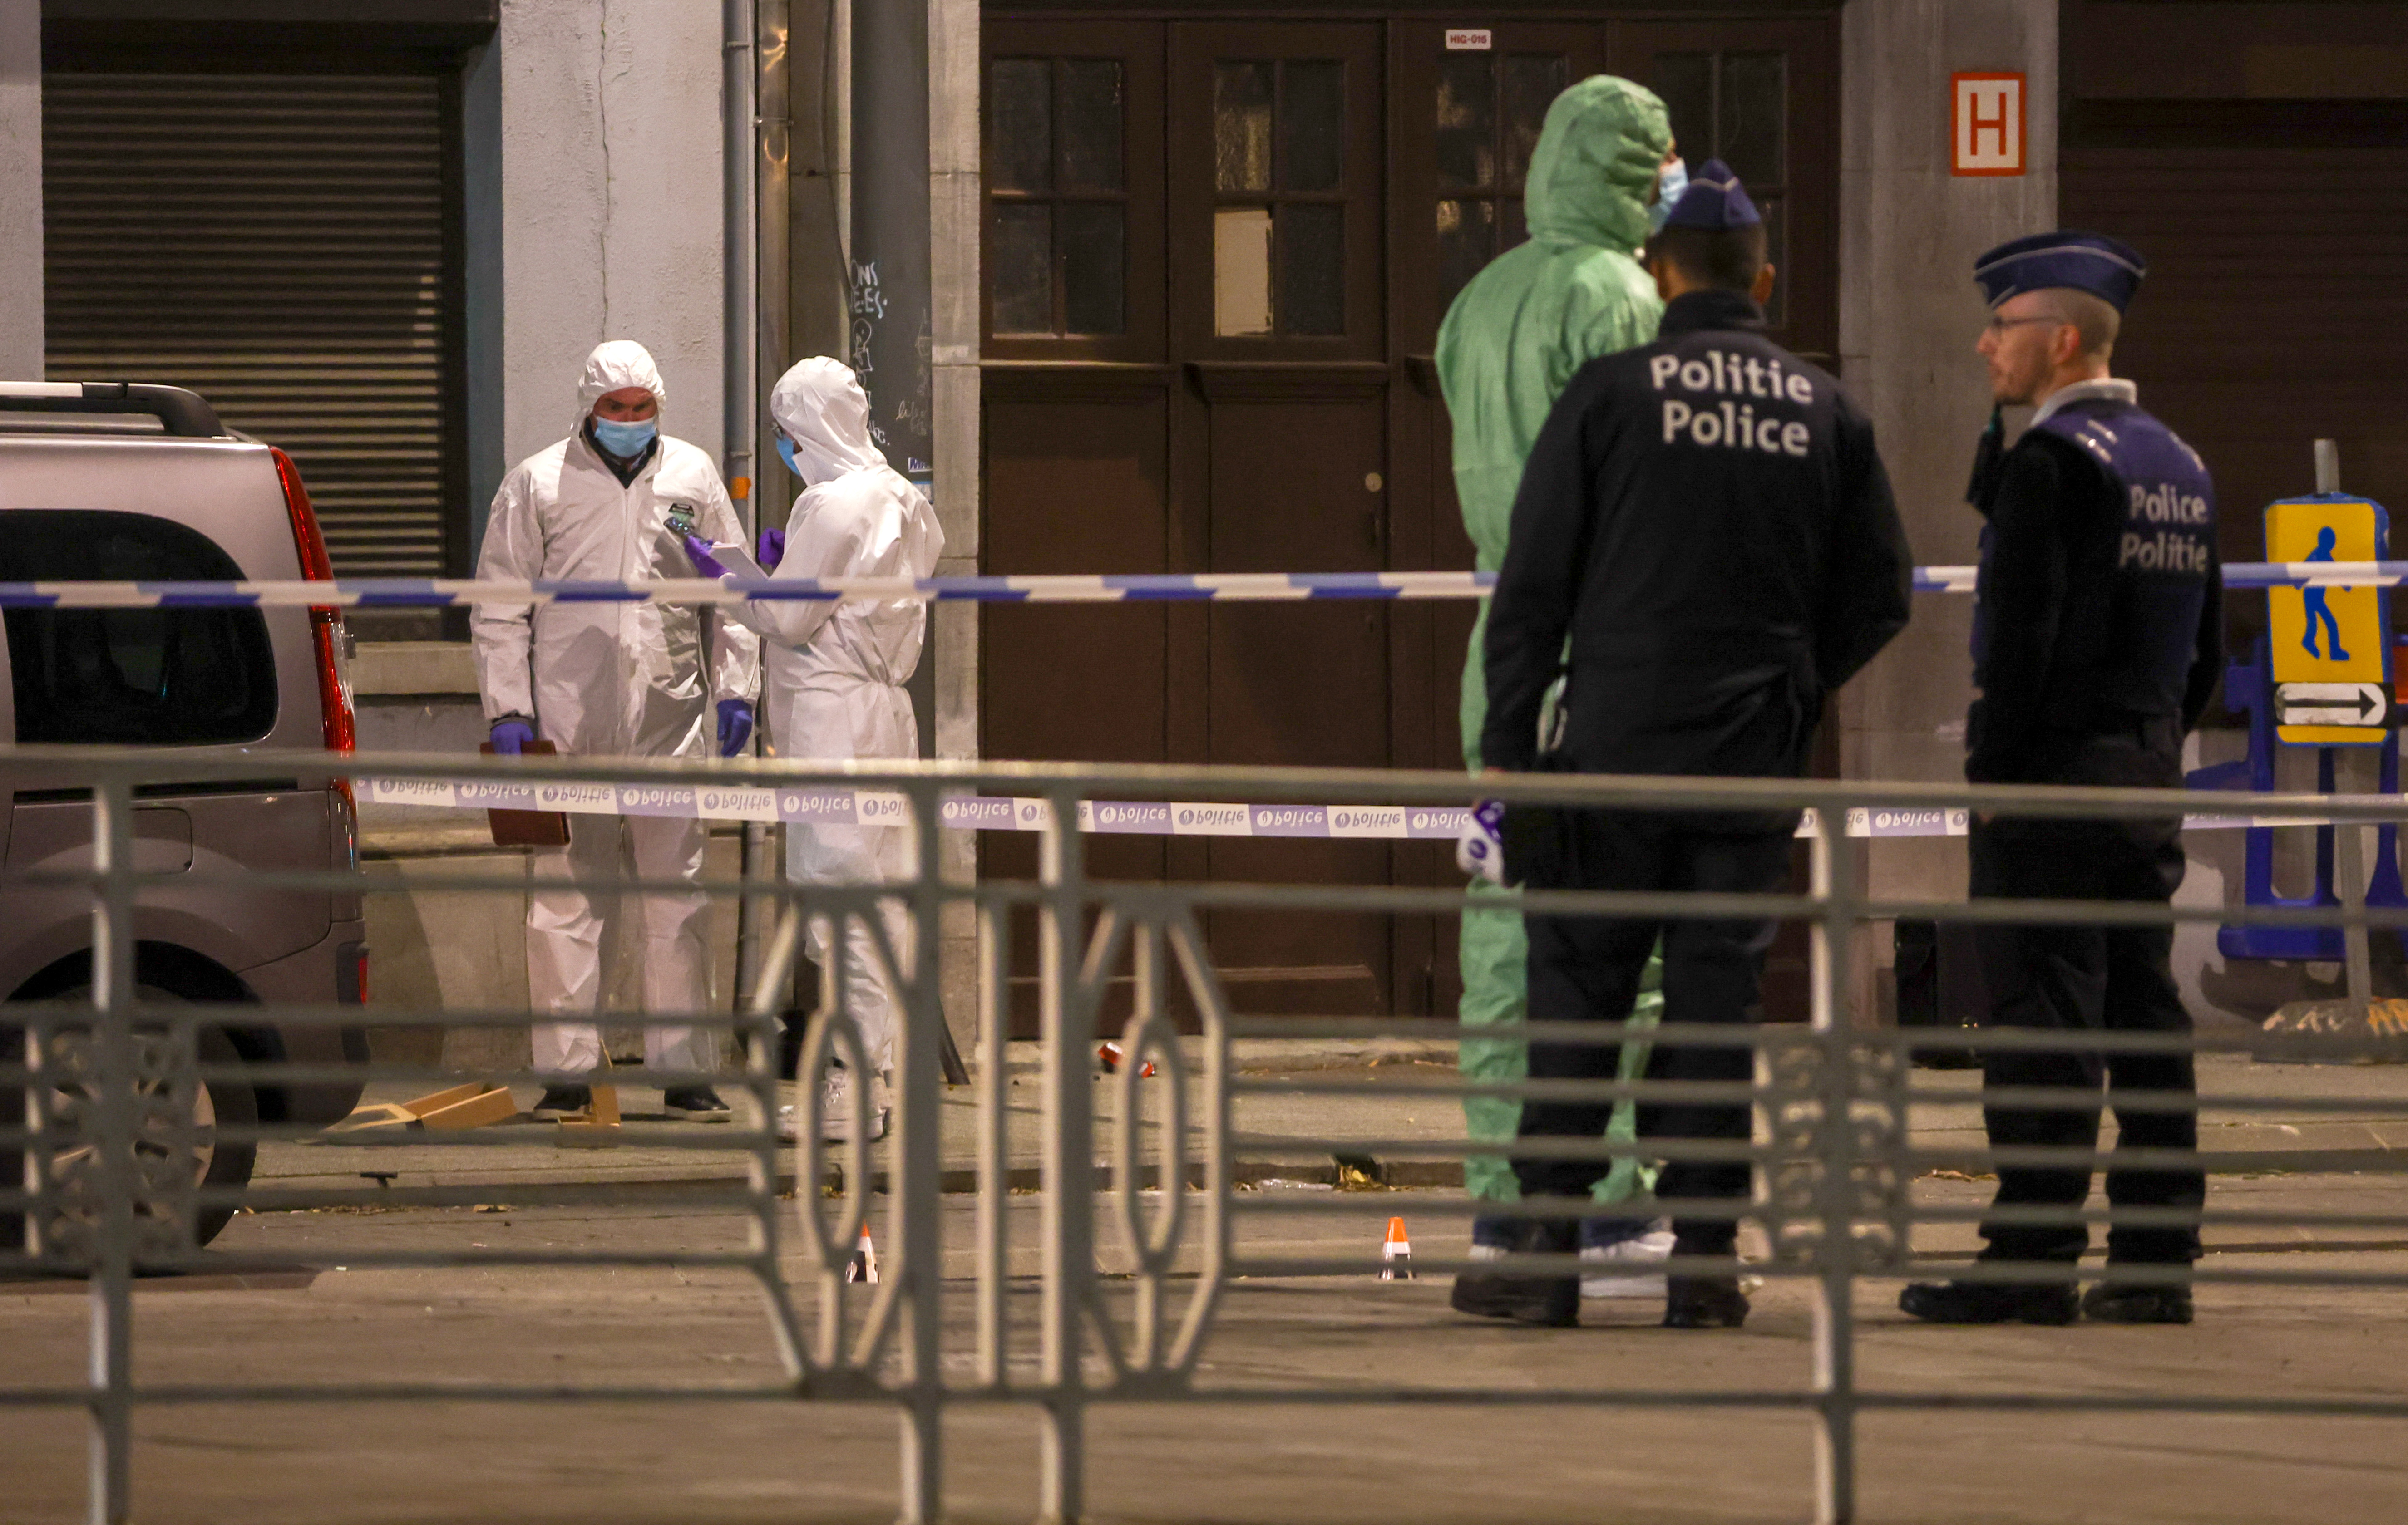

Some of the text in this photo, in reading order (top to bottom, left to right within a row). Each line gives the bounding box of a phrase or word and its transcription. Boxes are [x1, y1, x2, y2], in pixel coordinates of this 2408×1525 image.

[1970, 92, 2007, 156] H
[1649, 350, 1814, 406] Politie
[1662, 399, 1811, 458] Police
[2129, 483, 2208, 524] Police
[2118, 531, 2208, 572] Politie
